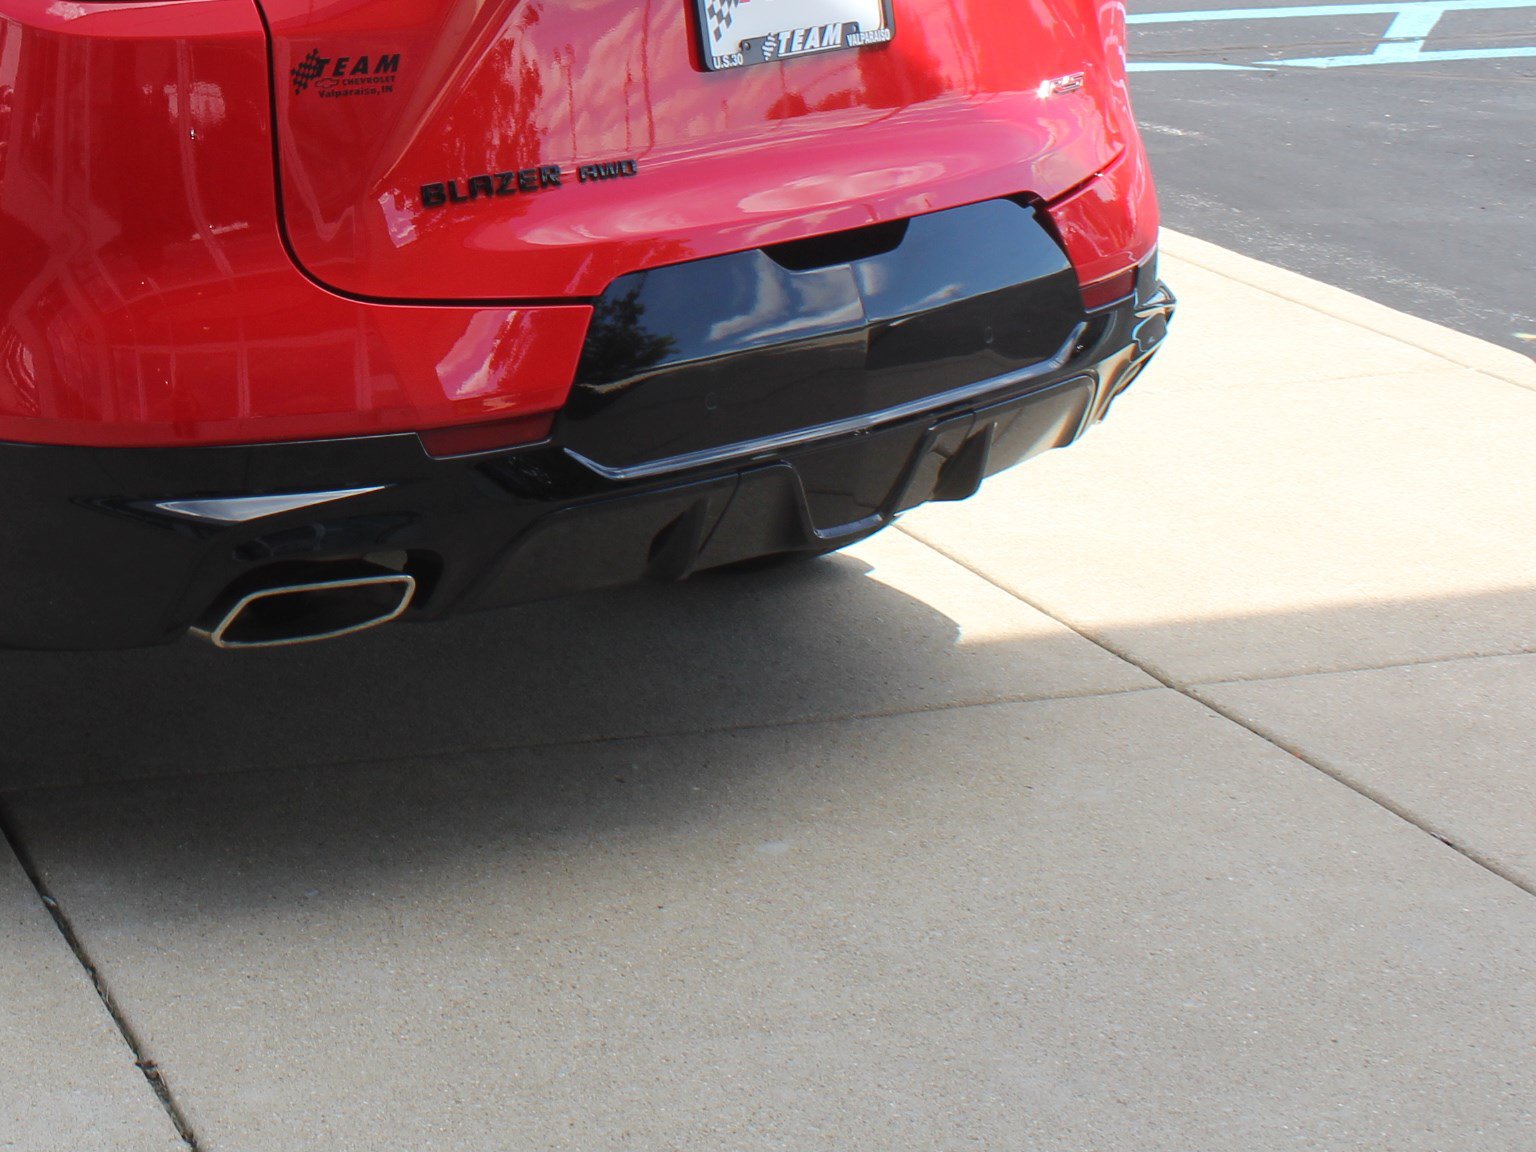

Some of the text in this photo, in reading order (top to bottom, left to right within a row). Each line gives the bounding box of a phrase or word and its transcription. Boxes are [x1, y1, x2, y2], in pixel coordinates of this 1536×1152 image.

[778, 22, 843, 56] TEAM
[846, 28, 891, 48] VALPARAISO
[315, 53, 401, 78] TEAM
[341, 75, 396, 86] CHEVROLET
[421, 158, 638, 209] BLAZER AWD
